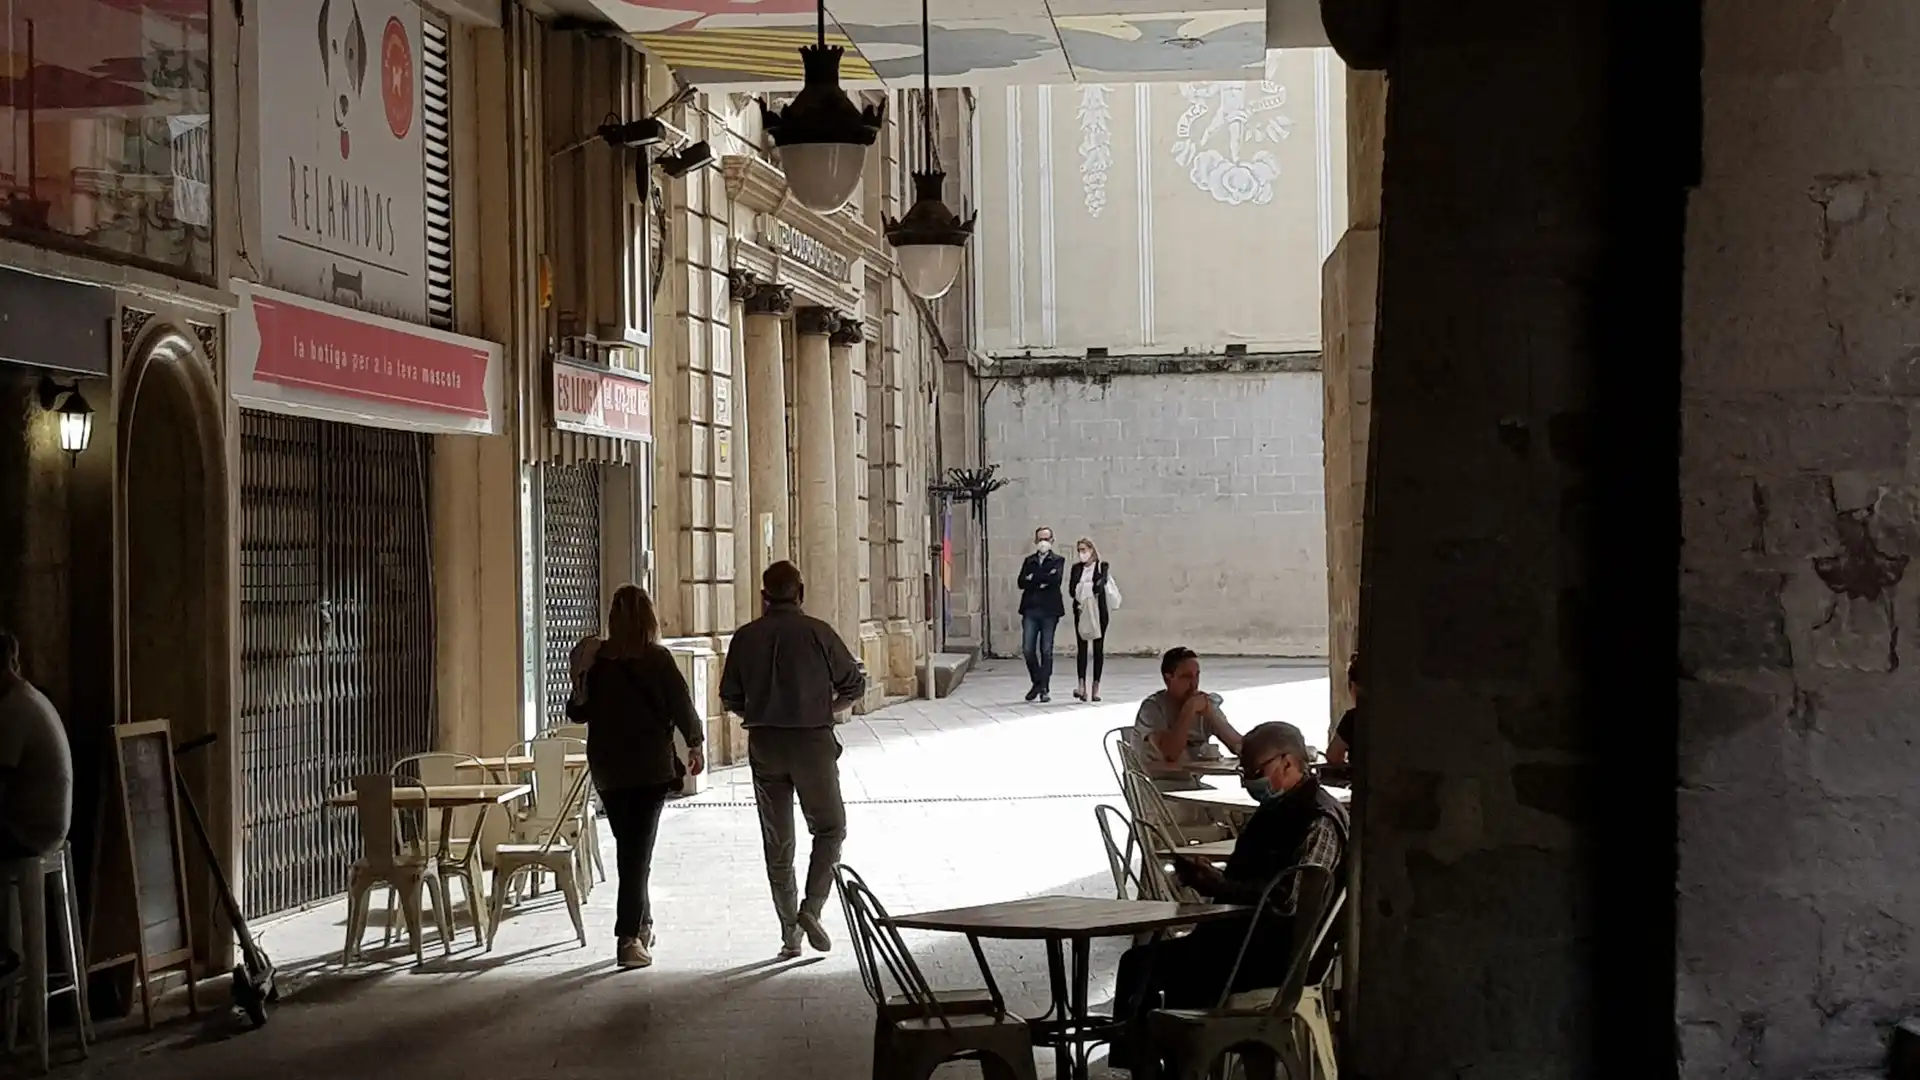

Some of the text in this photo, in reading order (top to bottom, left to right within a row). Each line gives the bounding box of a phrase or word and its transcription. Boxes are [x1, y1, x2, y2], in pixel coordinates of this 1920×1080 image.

[293, 335, 305, 358] la
[310, 339, 348, 370] botiga
[351, 353, 370, 373] per
[374, 357, 380, 374] a
[383, 356, 393, 377] la
[396, 359, 418, 381] teva
[557, 372, 569, 412] ES
